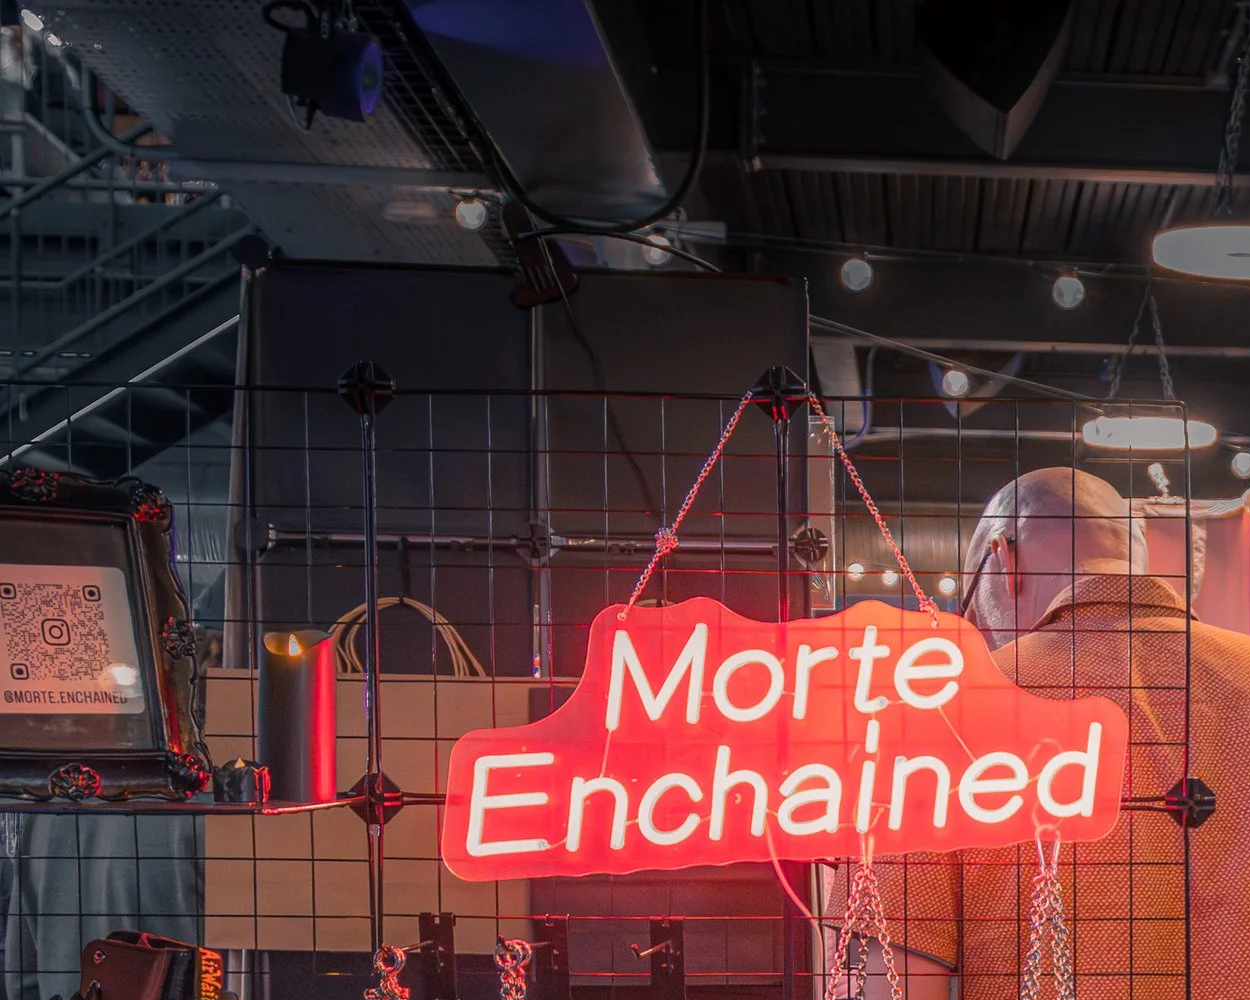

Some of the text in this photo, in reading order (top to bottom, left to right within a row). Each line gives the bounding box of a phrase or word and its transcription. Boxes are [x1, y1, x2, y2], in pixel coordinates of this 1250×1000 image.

[4, 690, 128, 704] @MORTE.ENCHAINED
[605, 622, 964, 730] Morte
[465, 720, 1102, 857] Enchained
